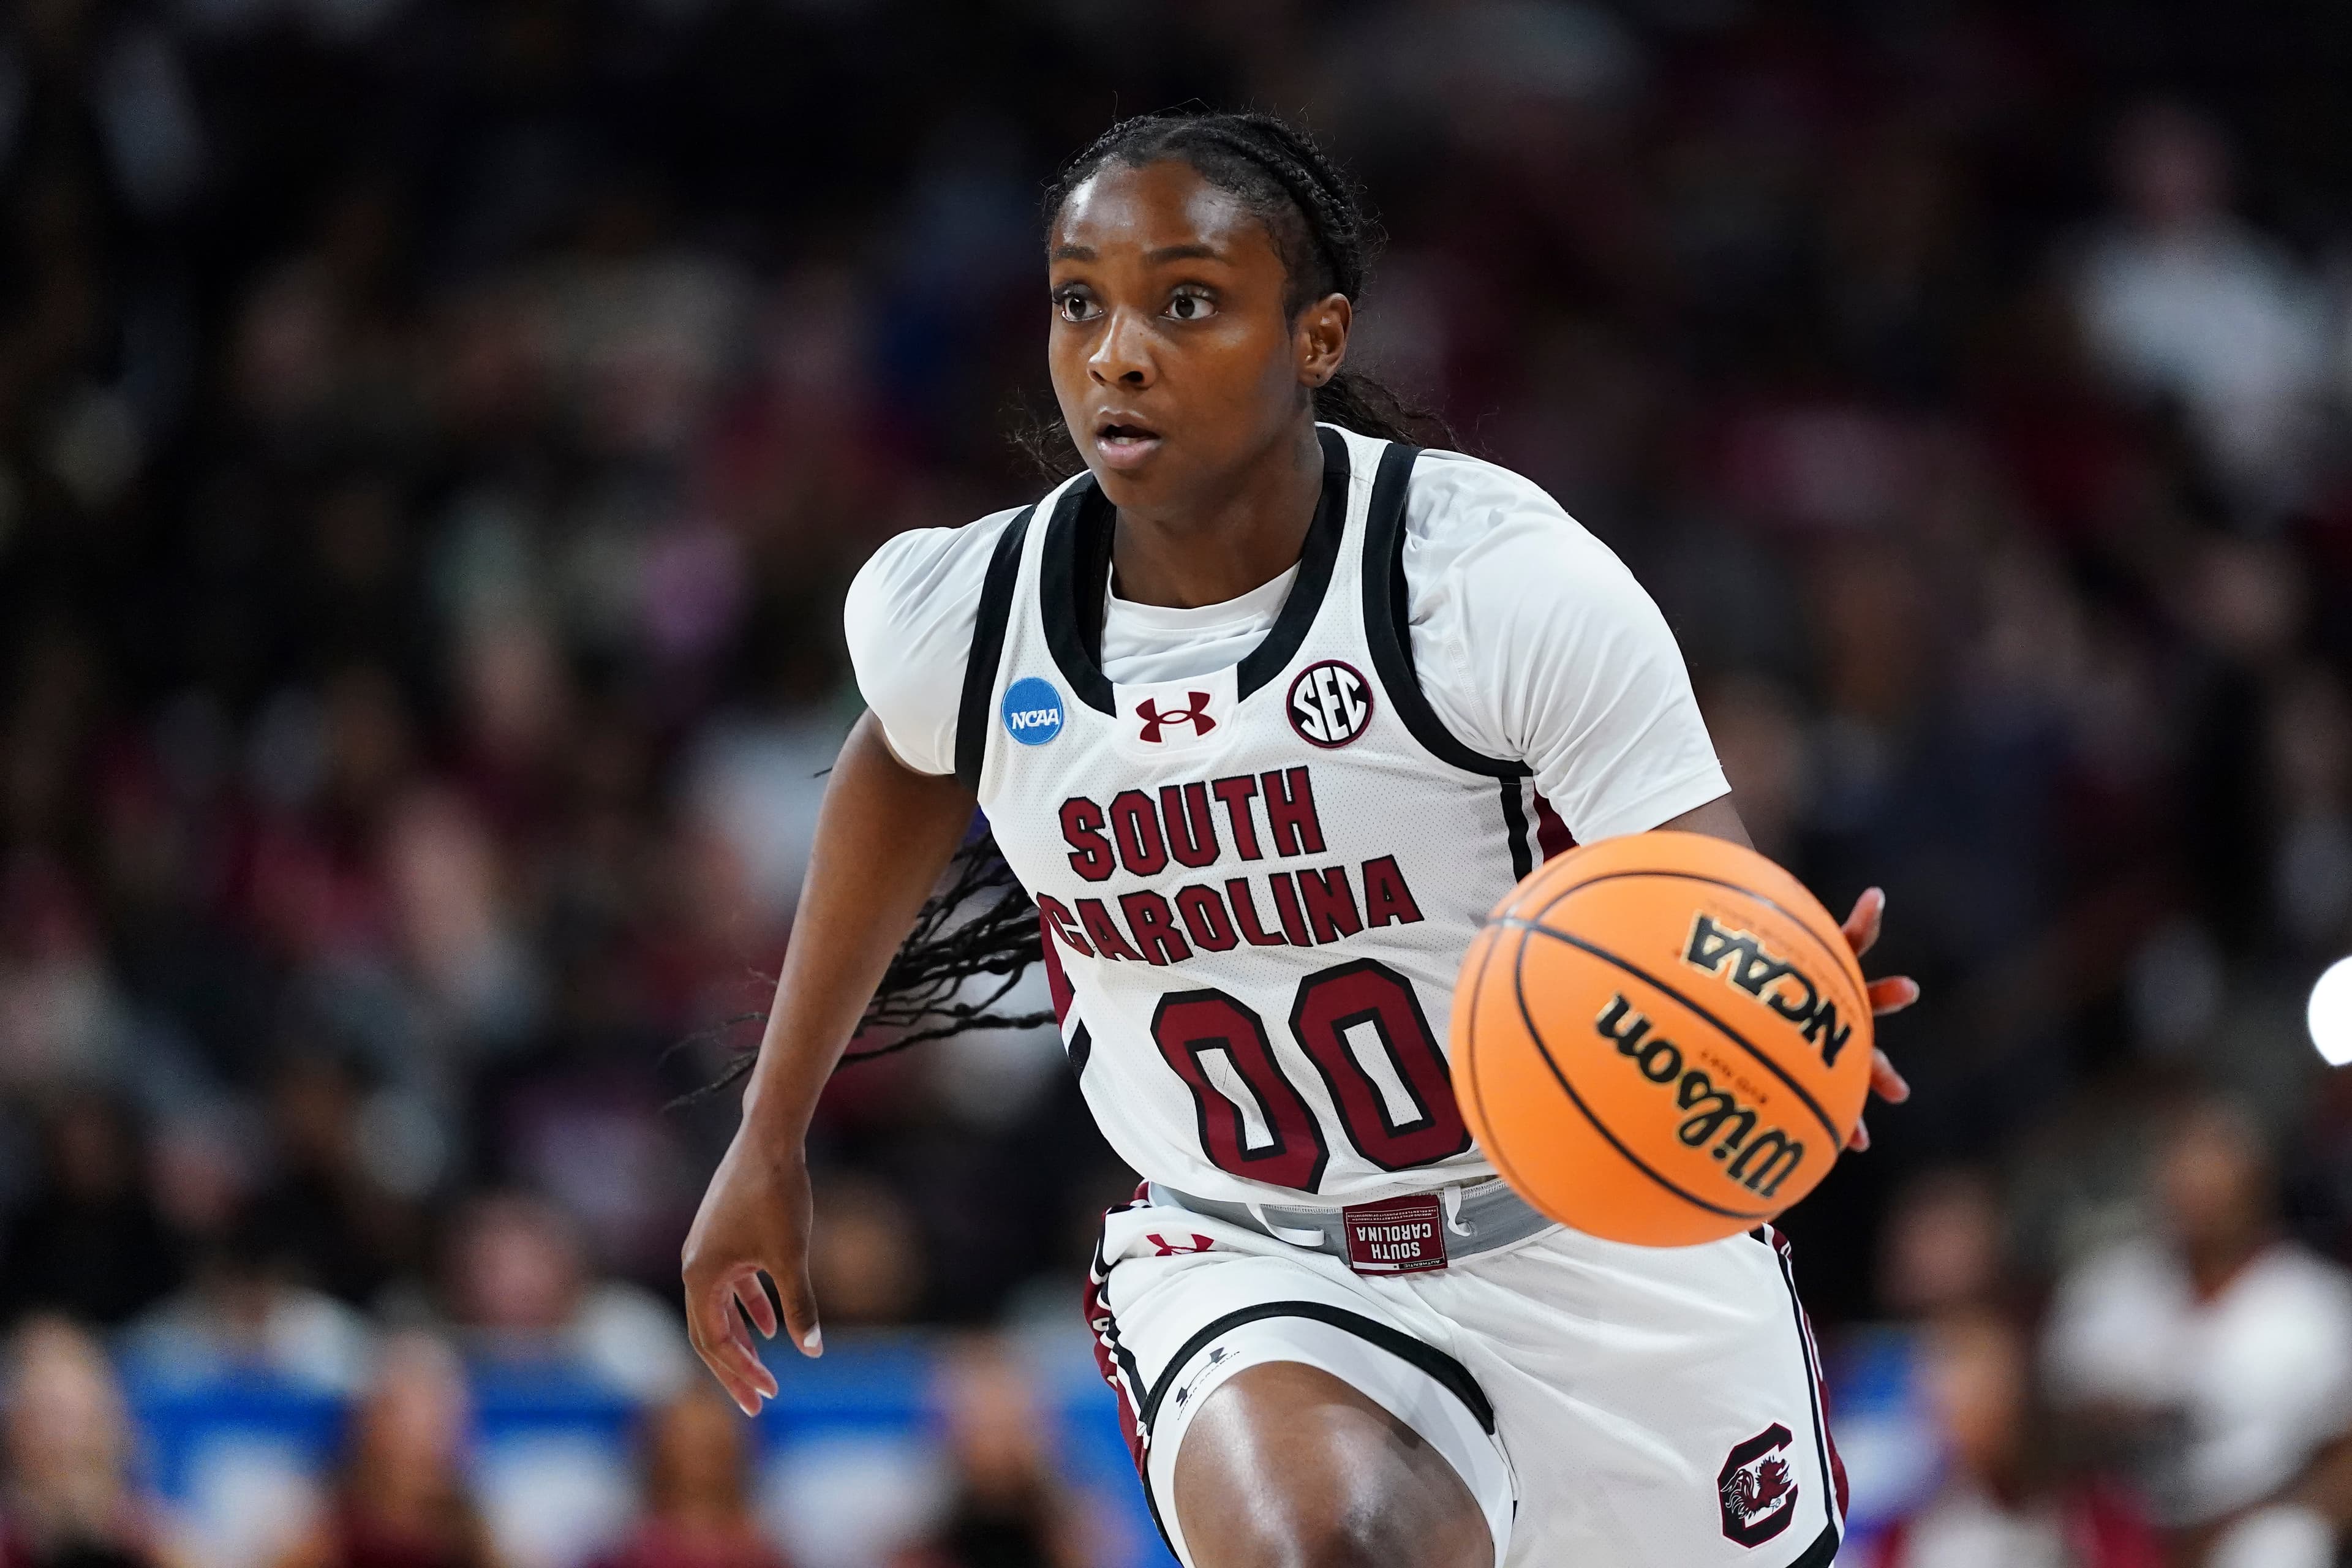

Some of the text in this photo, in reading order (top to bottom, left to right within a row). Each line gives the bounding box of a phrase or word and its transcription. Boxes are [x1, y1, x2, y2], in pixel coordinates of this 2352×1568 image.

[1011, 708, 1059, 729] NCAA
[1294, 666, 1366, 742] SEC
[1058, 765, 1327, 882] SOUTH
[1036, 854, 1424, 967] CAROLINA
[1683, 911, 1852, 1068] NCAA
[1150, 957, 1472, 1194] 00
[1596, 991, 1804, 1197] Wilson
[1356, 1223, 1432, 1242] CAROLINA
[1371, 1242, 1421, 1259] SOUTH
